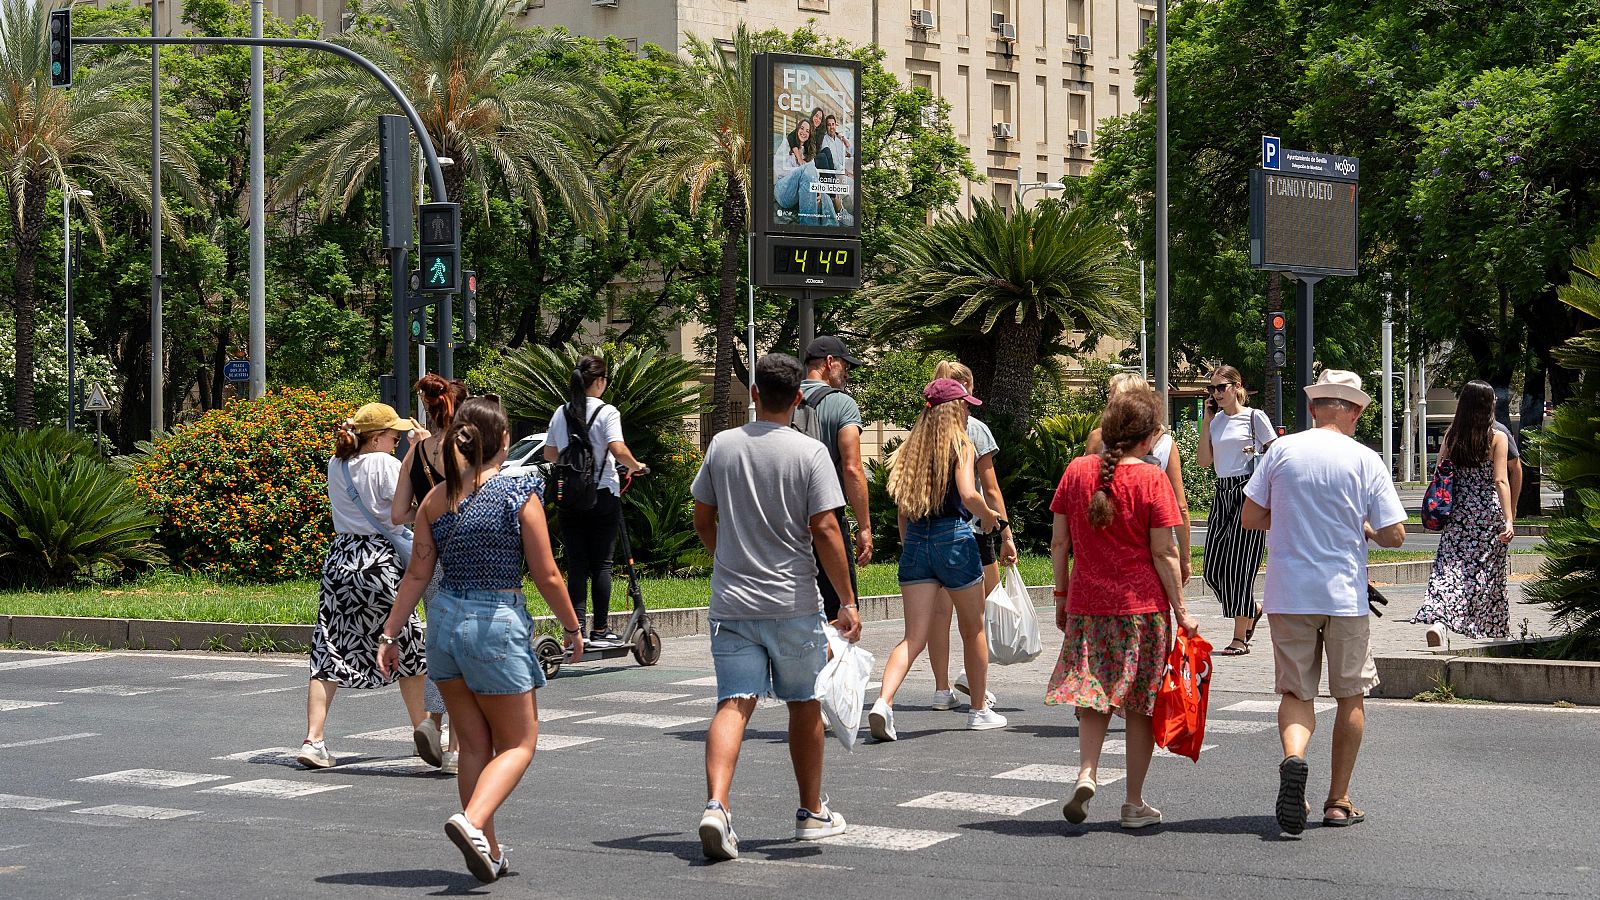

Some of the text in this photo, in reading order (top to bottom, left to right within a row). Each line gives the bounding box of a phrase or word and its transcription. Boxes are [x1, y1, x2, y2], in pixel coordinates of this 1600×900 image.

[783, 68, 810, 91] FP
[777, 92, 815, 113] CEU
[1266, 142, 1276, 163] P
[811, 183, 849, 193] éxito laboral
[1276, 177, 1299, 197] CANO
[1300, 180, 1307, 198] Y
[1308, 181, 1333, 201] CUETO
